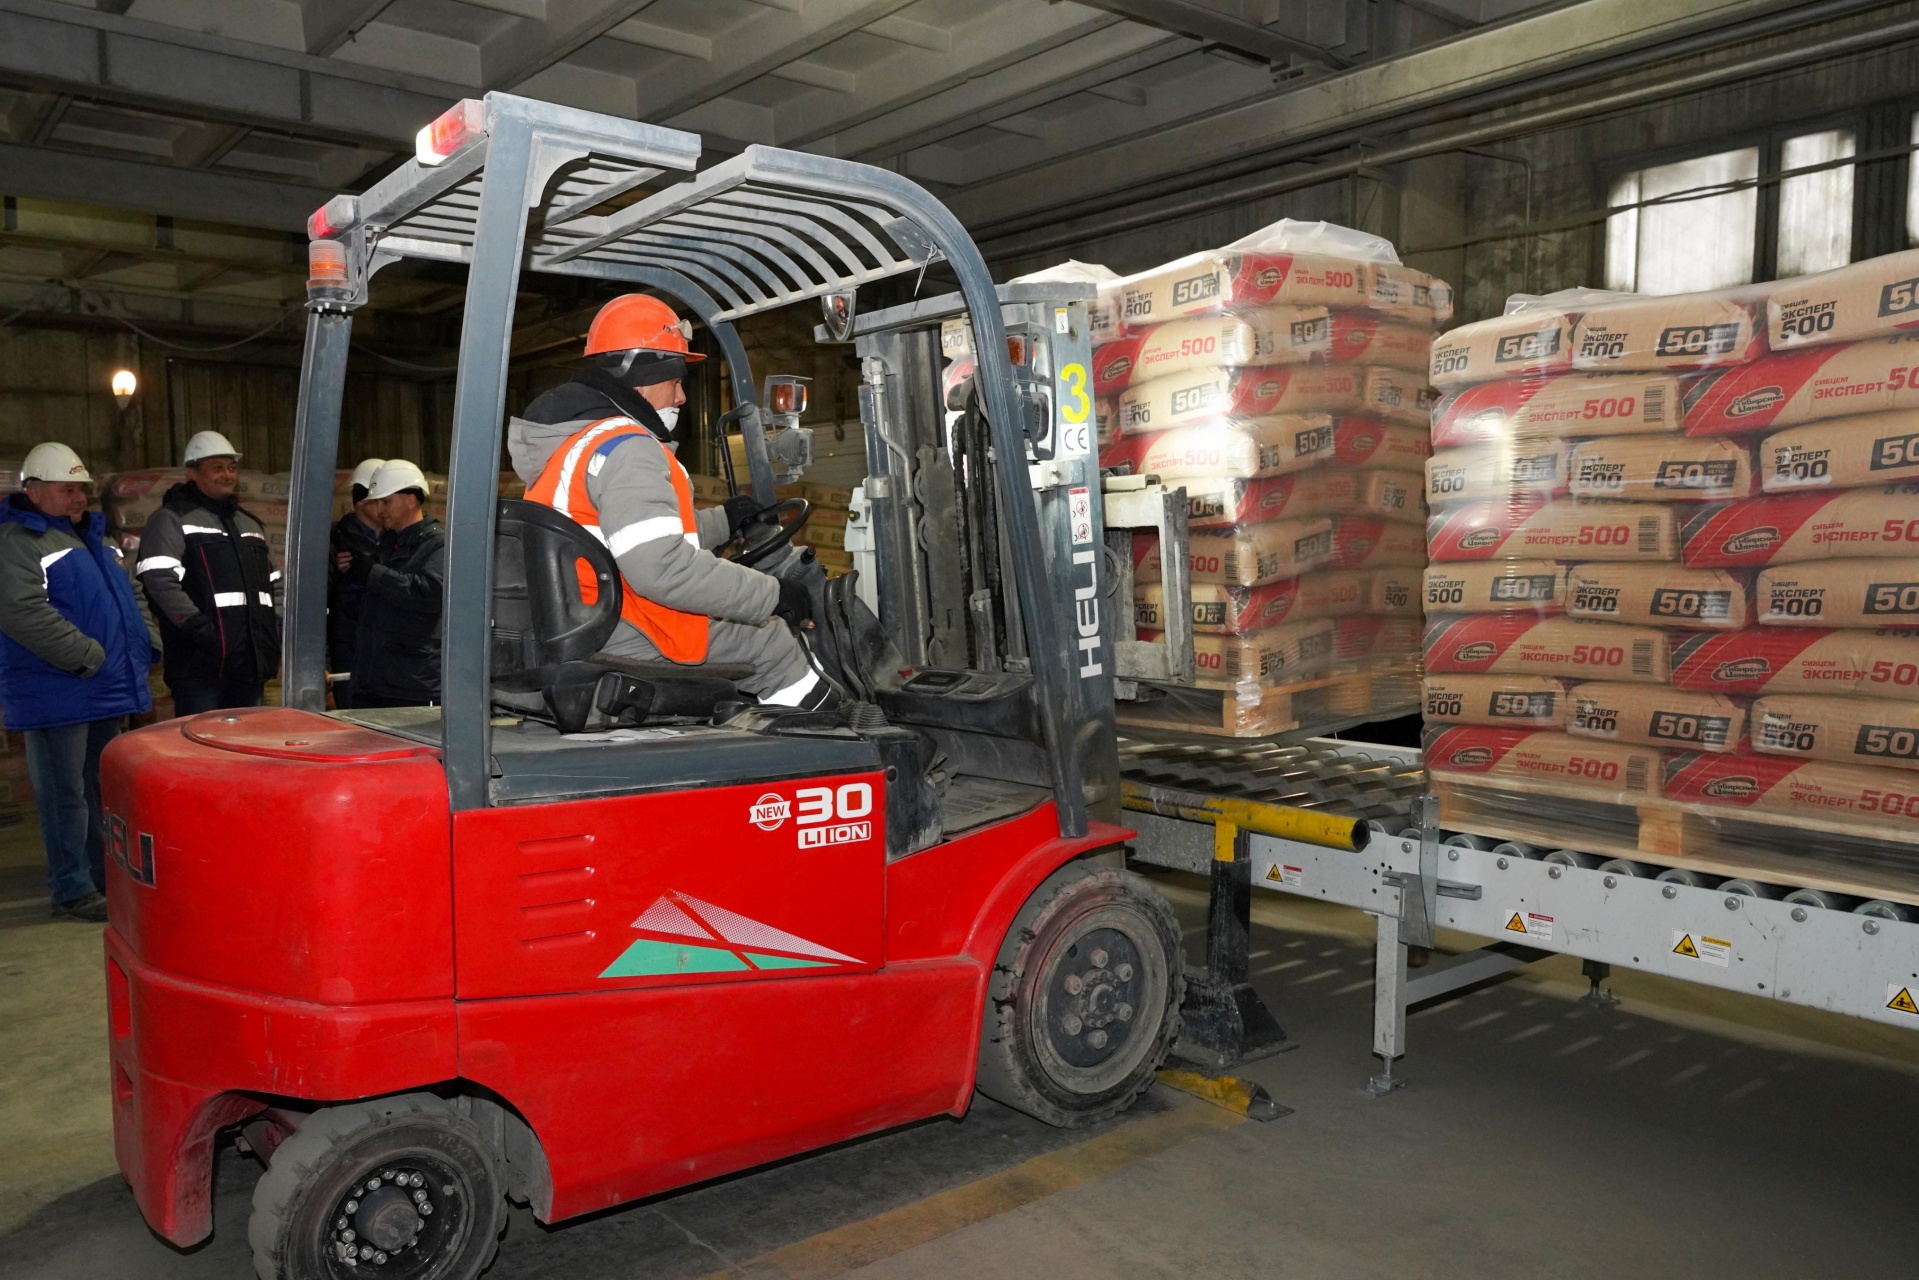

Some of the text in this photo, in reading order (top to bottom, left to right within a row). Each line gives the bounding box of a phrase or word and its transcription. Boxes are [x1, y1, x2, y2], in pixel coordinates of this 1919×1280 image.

[1325, 271, 1352, 288] 500
[1178, 279, 1215, 302] 50 КГ
[1888, 283, 1919, 311] 5
[1126, 300, 1151, 318] 500
[1781, 300, 1838, 321] ЭКСПЕРТ
[1780, 312, 1835, 340] 500
[1583, 333, 1628, 342] ЭКСПЕРТ
[1665, 330, 1705, 353] 50
[1145, 336, 1215, 364] ЭКСПЕРТ 500
[1502, 335, 1537, 359] 50
[1580, 342, 1624, 359] 500
[1433, 355, 1468, 375] 500
[1815, 376, 1849, 386] СИБЦЕМ
[1060, 363, 1090, 423] 3
[1176, 388, 1201, 411] 50
[1814, 382, 1884, 399] ЭКСПЕРТ
[1733, 394, 1783, 406] Сибирский
[1738, 402, 1773, 413] Цемент
[1528, 397, 1635, 422] ЭКСПЕРТ 500
[1299, 432, 1319, 453] 50
[1185, 450, 1220, 466] 500
[1432, 468, 1467, 480] ЭКСПЕРТ
[1581, 464, 1625, 472] ЭКСПЕРТ
[1663, 464, 1727, 487] 50 КГ
[1776, 460, 1828, 481] 500
[1432, 476, 1464, 494] 500
[1578, 472, 1622, 489] 500
[1524, 525, 1630, 546] ЭКСПЕРТ 500
[1812, 522, 1844, 531] СИБЦЕМ
[1730, 535, 1780, 545] Сибирский
[1812, 531, 1879, 543] ЭКСПЕРТ
[1257, 562, 1279, 579] 50
[1428, 588, 1463, 603] 500
[1497, 578, 1549, 599] 50 КГ
[1576, 586, 1621, 596] ЭКСПЕРТ
[1771, 589, 1825, 598] ЭКСПЕРТ
[1135, 603, 1158, 611] КСПЕРТ
[1574, 595, 1617, 612] 500
[1658, 592, 1699, 615] 50
[1770, 598, 1822, 616] 500
[1874, 586, 1919, 611] 50
[1072, 550, 1102, 679] HELI
[1193, 604, 1221, 623] 0 КГ
[1520, 645, 1624, 666] ЭКСПЕРТ 500
[1721, 663, 1770, 673] Сибирский
[1802, 661, 1919, 686] ЭКСПЕРТ 50
[1427, 701, 1462, 716] 500
[1495, 694, 1547, 714] 50 КГ
[1576, 706, 1619, 717] ЭКСПЕРТ
[1575, 714, 1617, 732] 500
[1657, 715, 1697, 738] 50
[1763, 730, 1815, 751] 500
[1866, 729, 1915, 755] 50
[1515, 756, 1618, 781] ЭКСПЕРТ 500
[1709, 780, 1759, 792] Сибирский
[1714, 789, 1748, 797] Цемент
[1789, 782, 1822, 791] СИБЦЕМ
[757, 805, 785, 819] NEW
[796, 782, 872, 825] 30
[1790, 789, 1919, 818] ЭКСПЕРТ 500
[830, 824, 867, 843] ION
[103, 806, 157, 889] ELI
